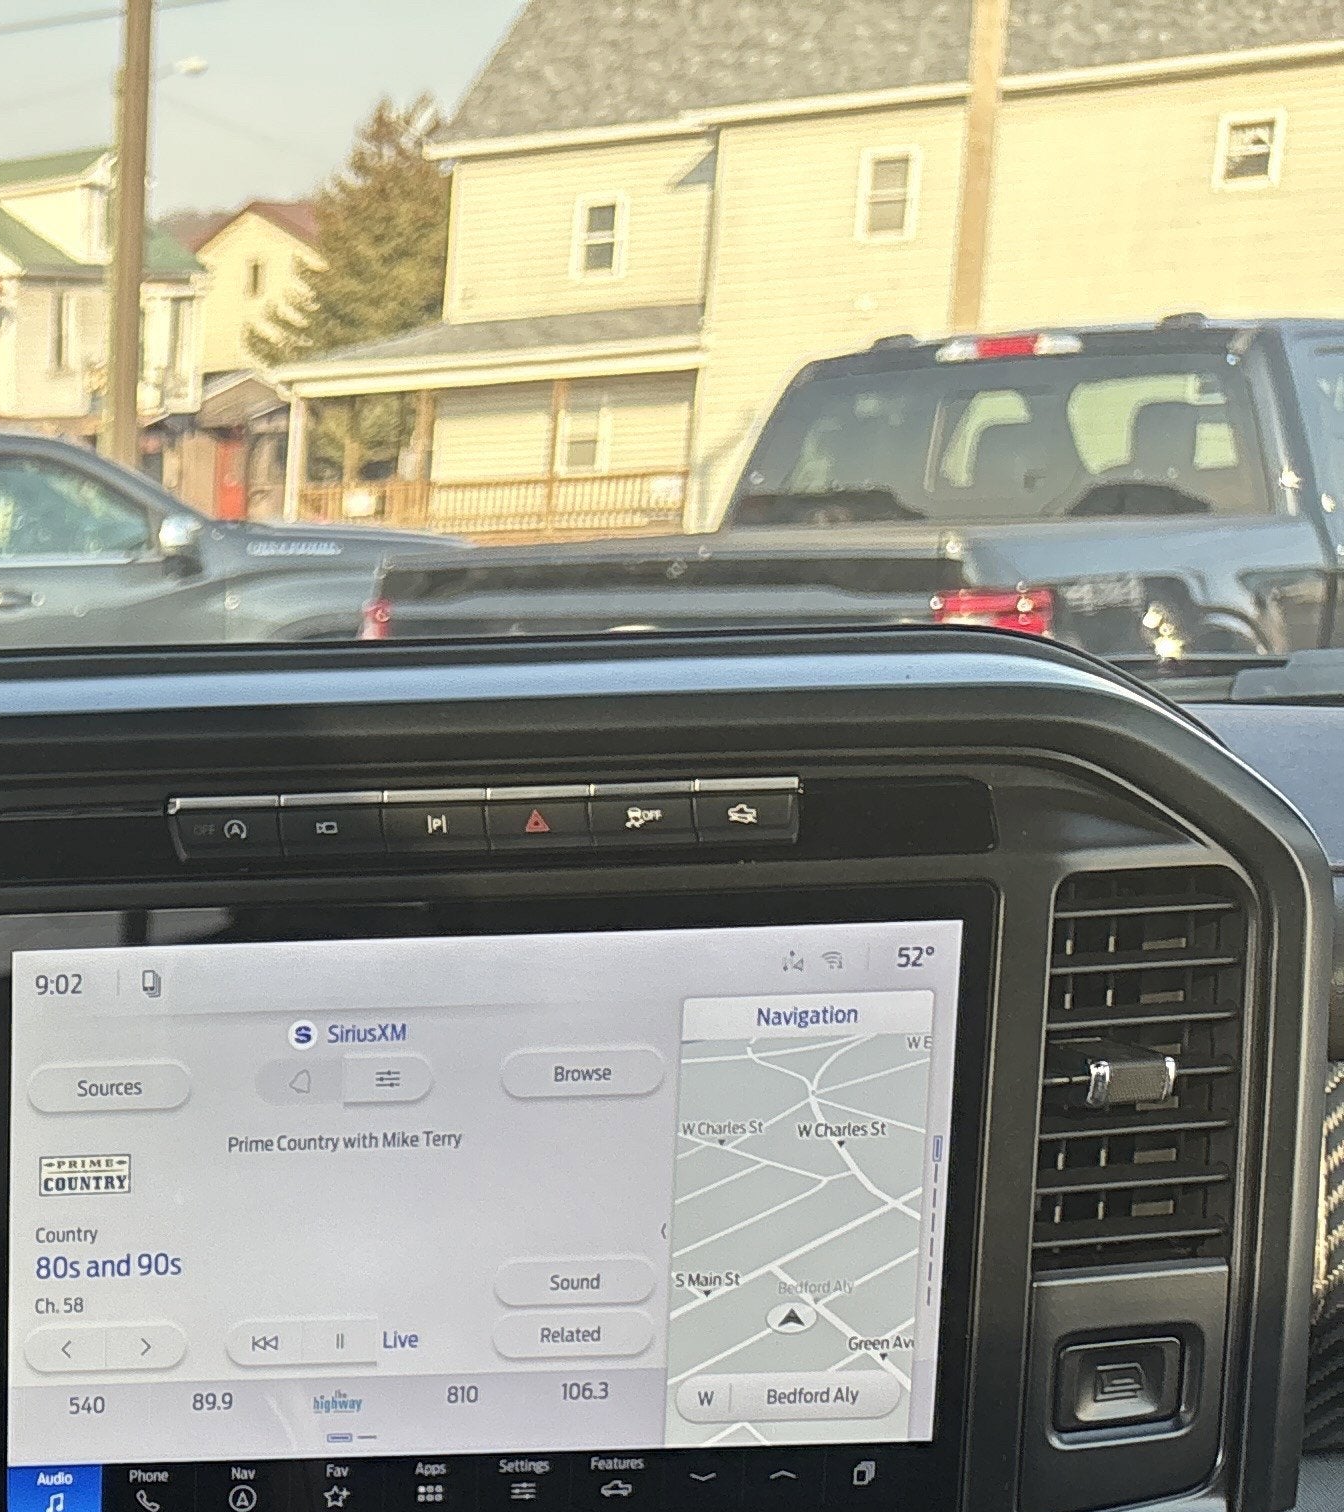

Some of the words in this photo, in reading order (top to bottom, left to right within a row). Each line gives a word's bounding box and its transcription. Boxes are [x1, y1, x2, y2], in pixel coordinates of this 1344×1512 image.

[642, 807, 662, 822] OFF
[897, 945, 935, 968] 52°
[35, 973, 83, 996] 9:02
[756, 1005, 859, 1028] Navigation
[327, 1023, 407, 1044] SiriusXM
[554, 1065, 612, 1082] Browse
[77, 1079, 142, 1098] Sources
[682, 1122, 695, 1135] W
[698, 1120, 746, 1136] Charles
[749, 1119, 764, 1134] St
[798, 1124, 812, 1137] W
[815, 1121, 864, 1138] Charles
[869, 1121, 886, 1136] St
[228, 1136, 274, 1153] Prime
[277, 1134, 339, 1154] Country
[343, 1132, 379, 1149] with
[382, 1131, 419, 1149] Mike
[422, 1130, 462, 1150] Terry
[56, 1158, 114, 1170] PRIME
[43, 1174, 128, 1192] COUNTRY
[36, 1227, 98, 1245] Country
[36, 1256, 81, 1279] 80s
[87, 1254, 130, 1277] and
[137, 1252, 182, 1276] 90s
[550, 1273, 600, 1291] Sound
[675, 1273, 685, 1288] S
[688, 1272, 720, 1288] Main
[724, 1271, 740, 1287] St
[778, 1280, 822, 1295] Bedford
[825, 1279, 853, 1296] Aly
[35, 1299, 59, 1314] Ch.
[63, 1297, 84, 1314] 58
[383, 1331, 419, 1349] Live
[540, 1326, 601, 1344] Related
[848, 1336, 889, 1351] Green
[447, 1385, 479, 1403] 810
[561, 1381, 609, 1400] 106.3
[698, 1390, 714, 1405] W
[767, 1388, 829, 1405] Bedford
[833, 1388, 859, 1406] Aly
[69, 1396, 105, 1414] 540
[192, 1393, 233, 1411] 89.9
[313, 1395, 363, 1413] highway
[326, 1464, 349, 1478] Fav
[415, 1461, 447, 1478] Apps
[499, 1458, 550, 1475] Settings
[590, 1456, 644, 1471] Features
[37, 1471, 73, 1486] Audio
[129, 1468, 169, 1482] Phone
[231, 1466, 256, 1480] Nav
